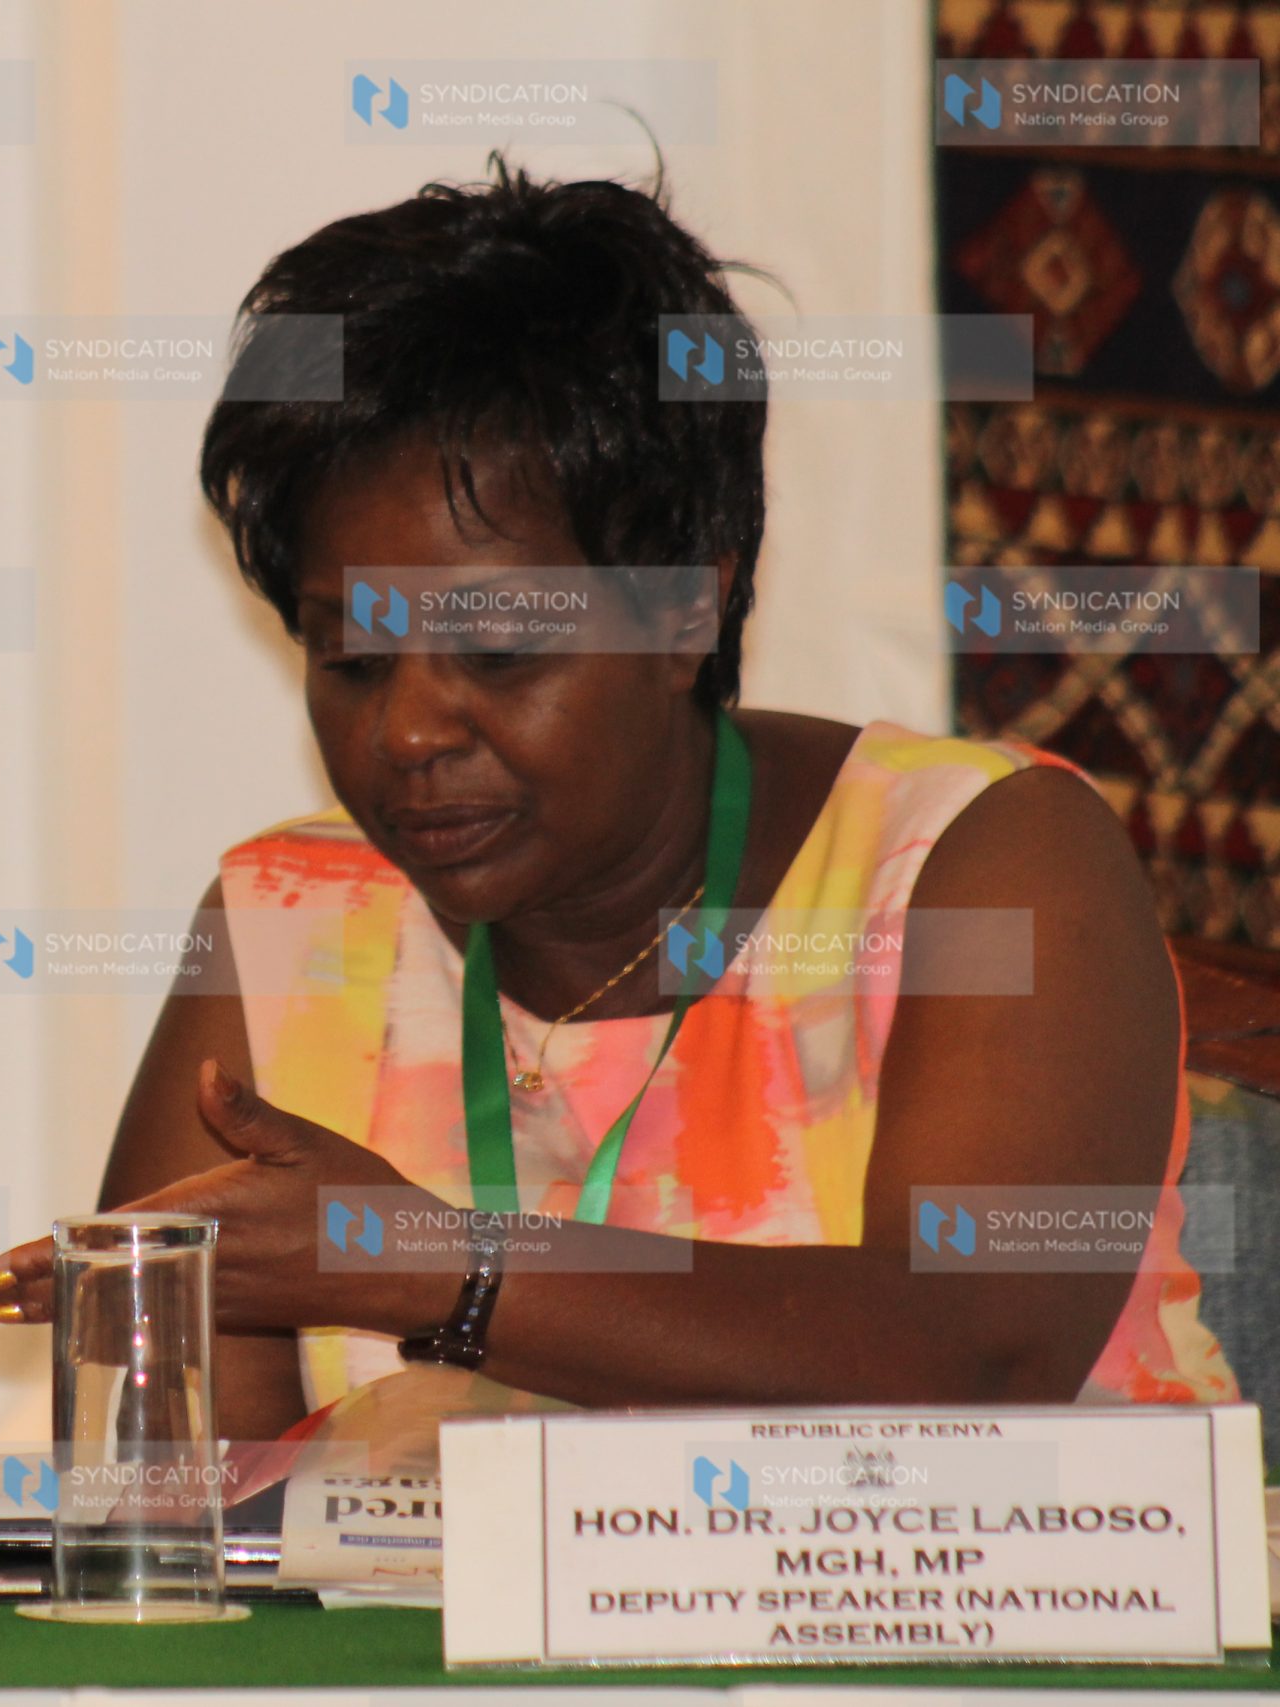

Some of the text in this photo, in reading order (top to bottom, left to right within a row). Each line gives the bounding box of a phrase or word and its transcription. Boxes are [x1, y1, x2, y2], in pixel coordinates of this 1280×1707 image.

[750, 1423, 1003, 1439] REPUBLIC OF KENYA
[573, 1504, 1187, 1539] HON. DR. JOYCE LABOSO,
[775, 1547, 985, 1579] MGH, MP
[588, 1587, 1177, 1614] DEPUTY SPEAKER (NATIONAL
[768, 1621, 995, 1647] ASSEMBLY)
